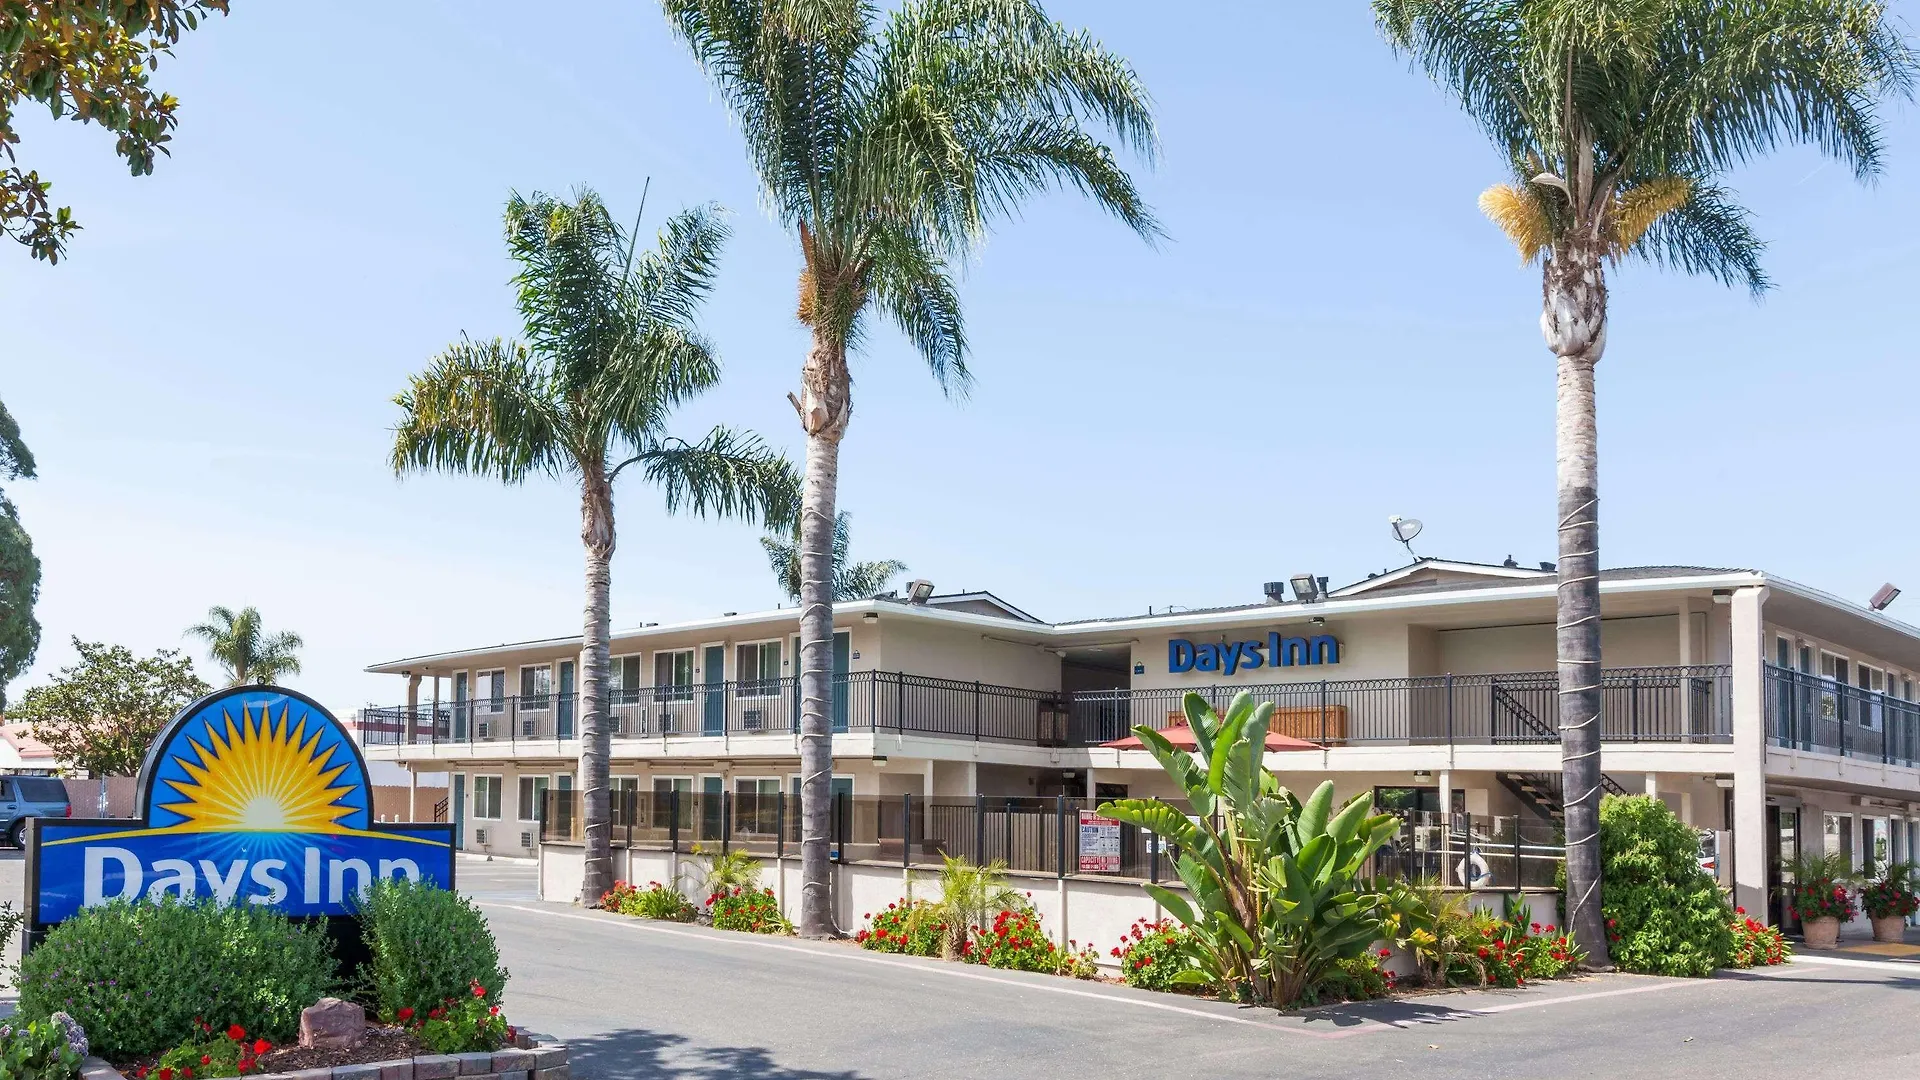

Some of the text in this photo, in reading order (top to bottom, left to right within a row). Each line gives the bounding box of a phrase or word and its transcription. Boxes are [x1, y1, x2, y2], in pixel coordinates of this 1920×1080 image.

[1168, 631, 1340, 676] Days Inn
[83, 846, 288, 909] Days
